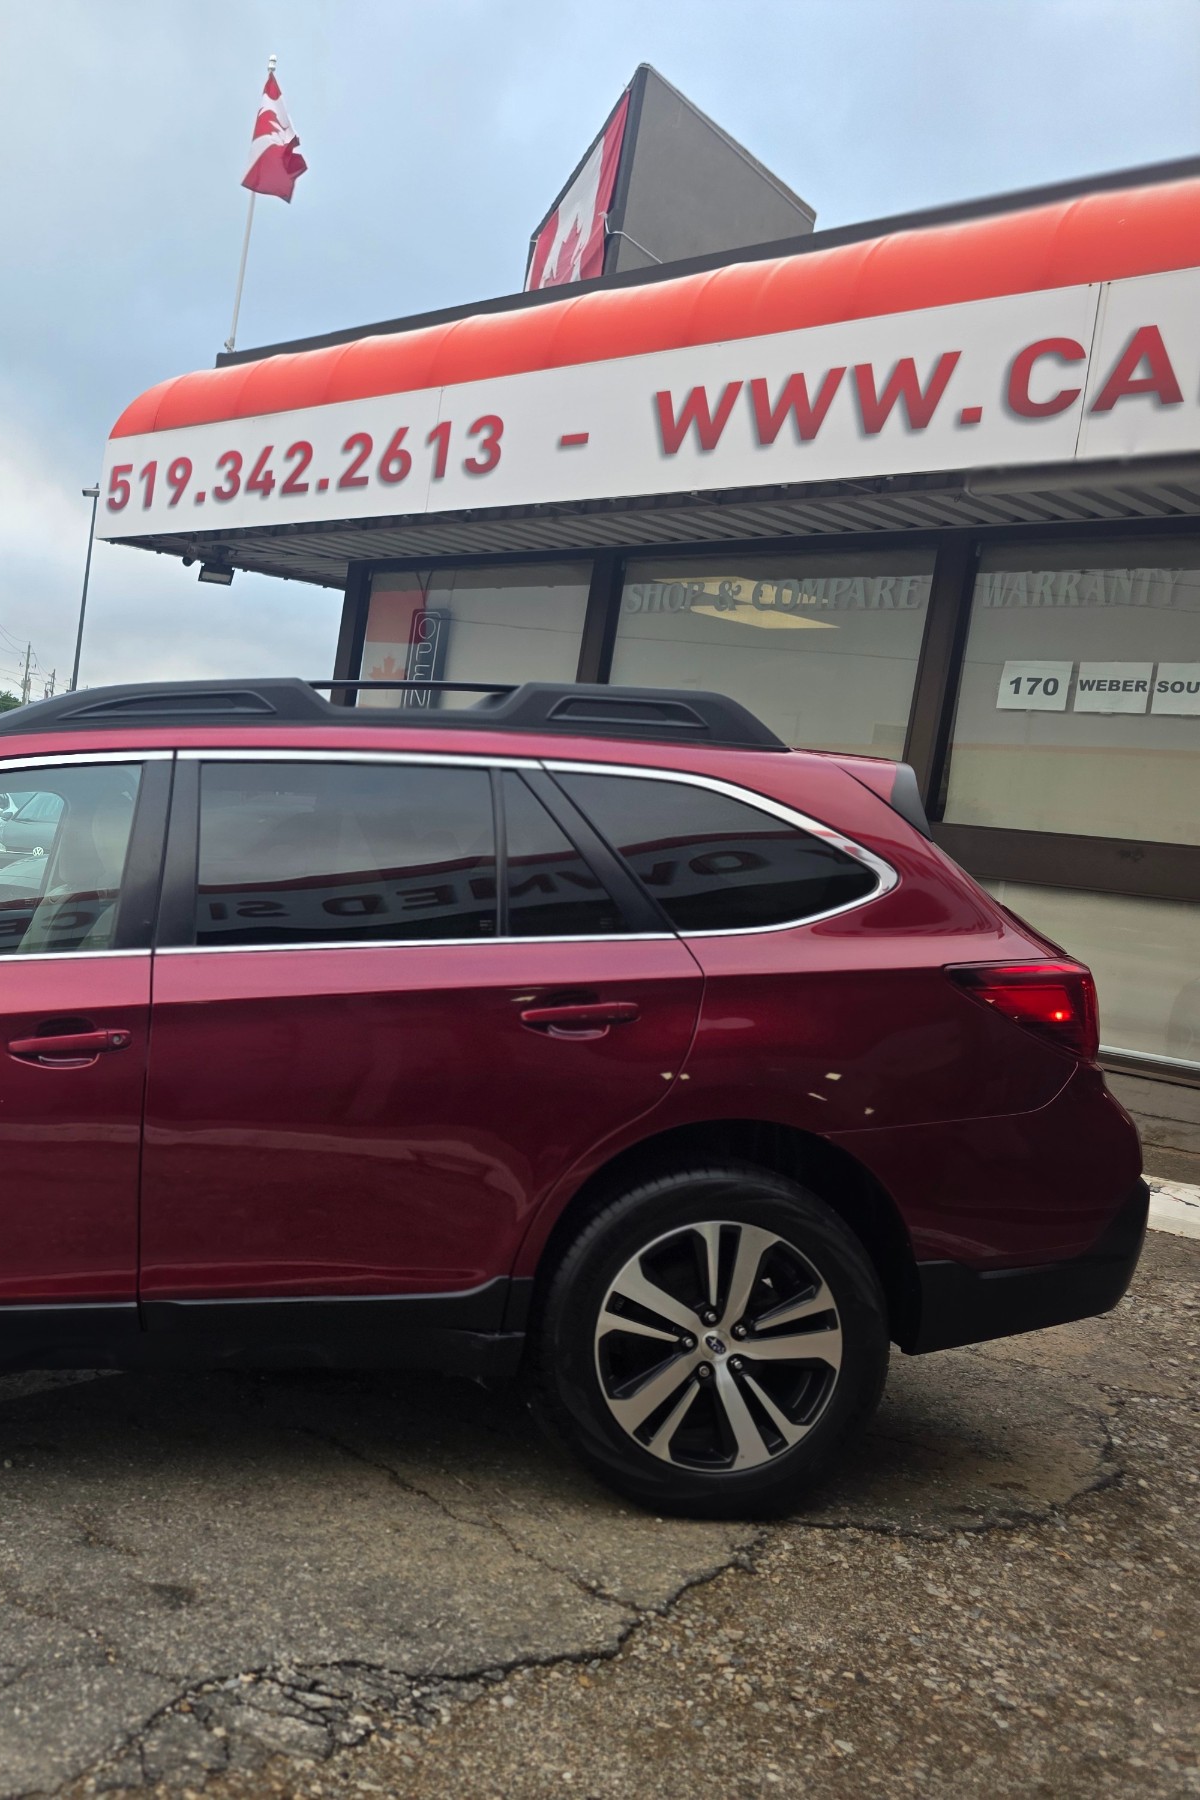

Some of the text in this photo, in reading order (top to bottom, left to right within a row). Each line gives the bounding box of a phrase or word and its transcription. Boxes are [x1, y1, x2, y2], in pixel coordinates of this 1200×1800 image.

[107, 413, 505, 511] 519.342.2613
[655, 324, 1185, 456] WWW.CA
[621, 575, 922, 614] SHOP & COMPARE
[982, 568, 1183, 608] WARRANTY
[1008, 676, 1200, 696] 170 WEBER SOU
